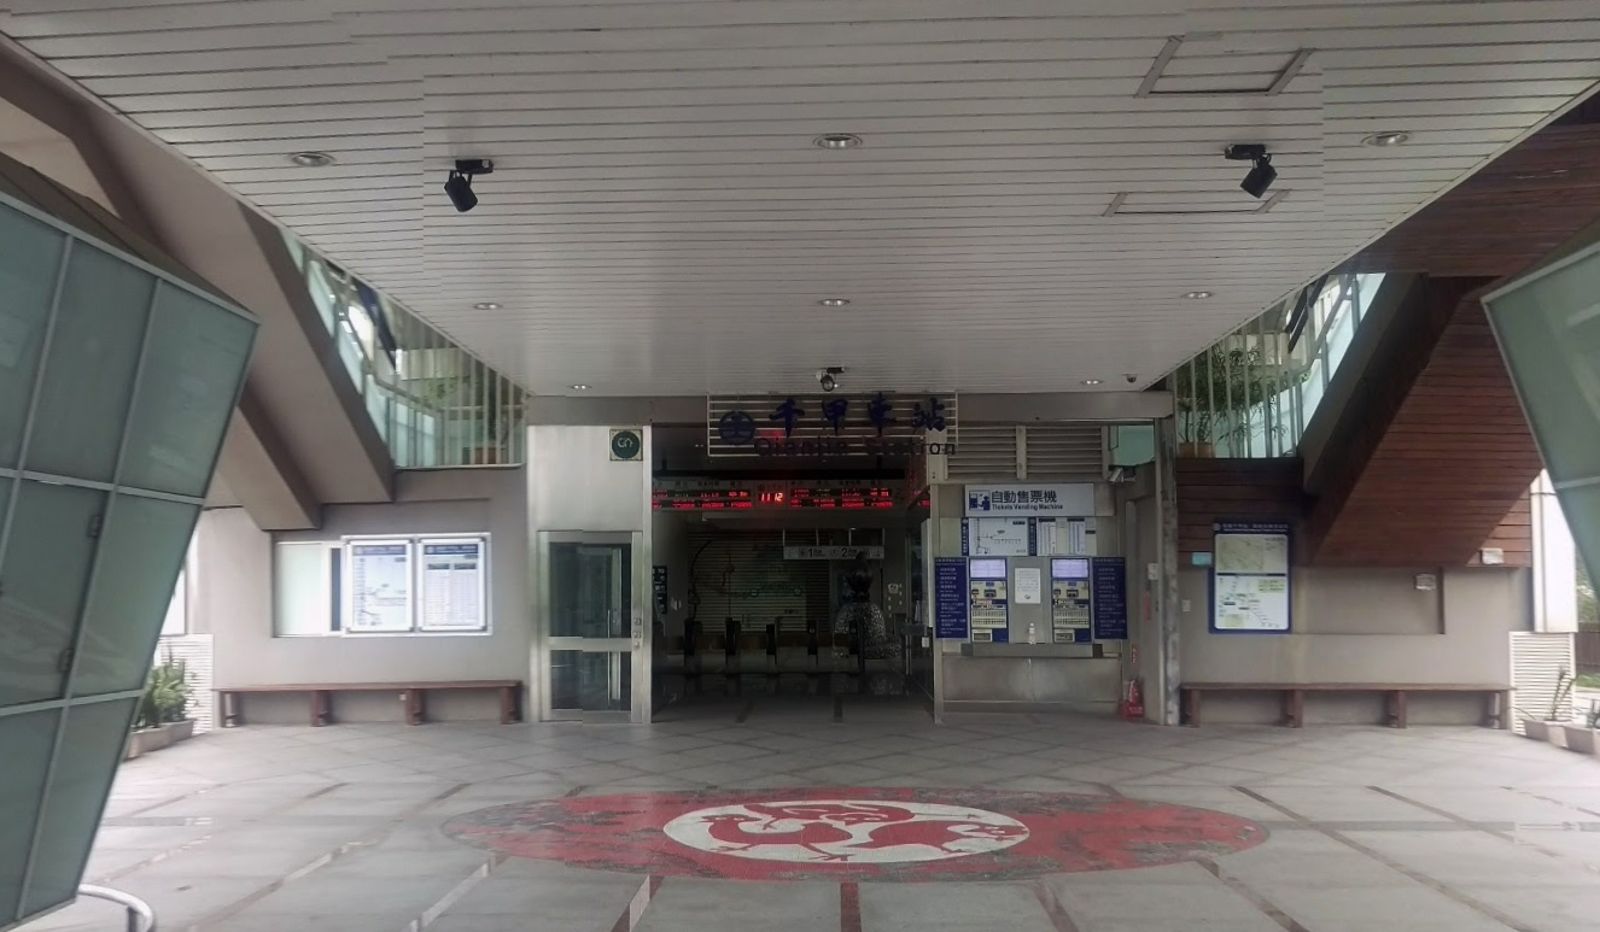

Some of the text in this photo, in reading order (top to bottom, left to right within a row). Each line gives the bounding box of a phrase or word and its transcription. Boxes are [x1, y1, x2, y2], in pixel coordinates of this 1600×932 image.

[992, 490, 1057, 503] 自動售票機
